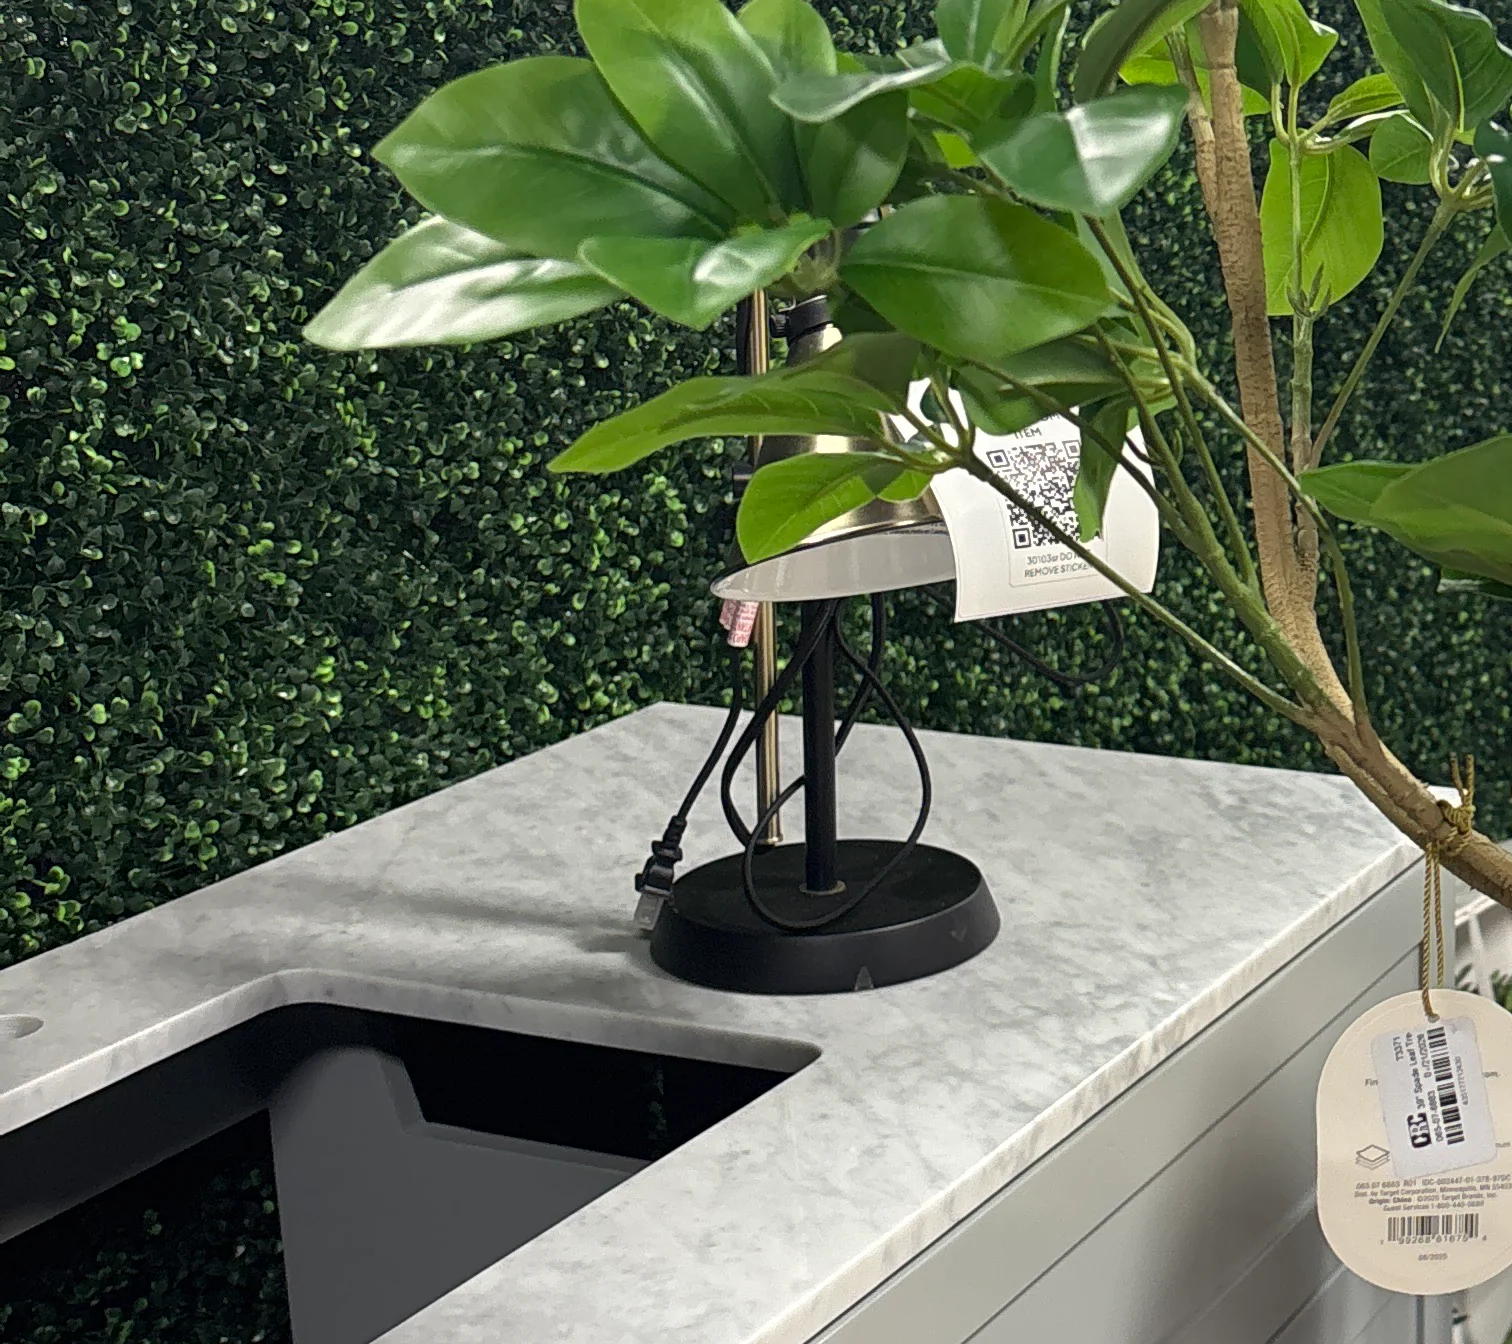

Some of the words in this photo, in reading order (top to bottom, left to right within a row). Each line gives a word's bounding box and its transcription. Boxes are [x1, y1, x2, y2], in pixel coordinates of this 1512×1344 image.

[1060, 552, 1073, 562] DO
[1024, 566, 1059, 578] REMOVE
[1060, 563, 1094, 573] STICKE
[1407, 1049, 1418, 1067] Leaf
[1412, 1067, 1423, 1094] Spade
